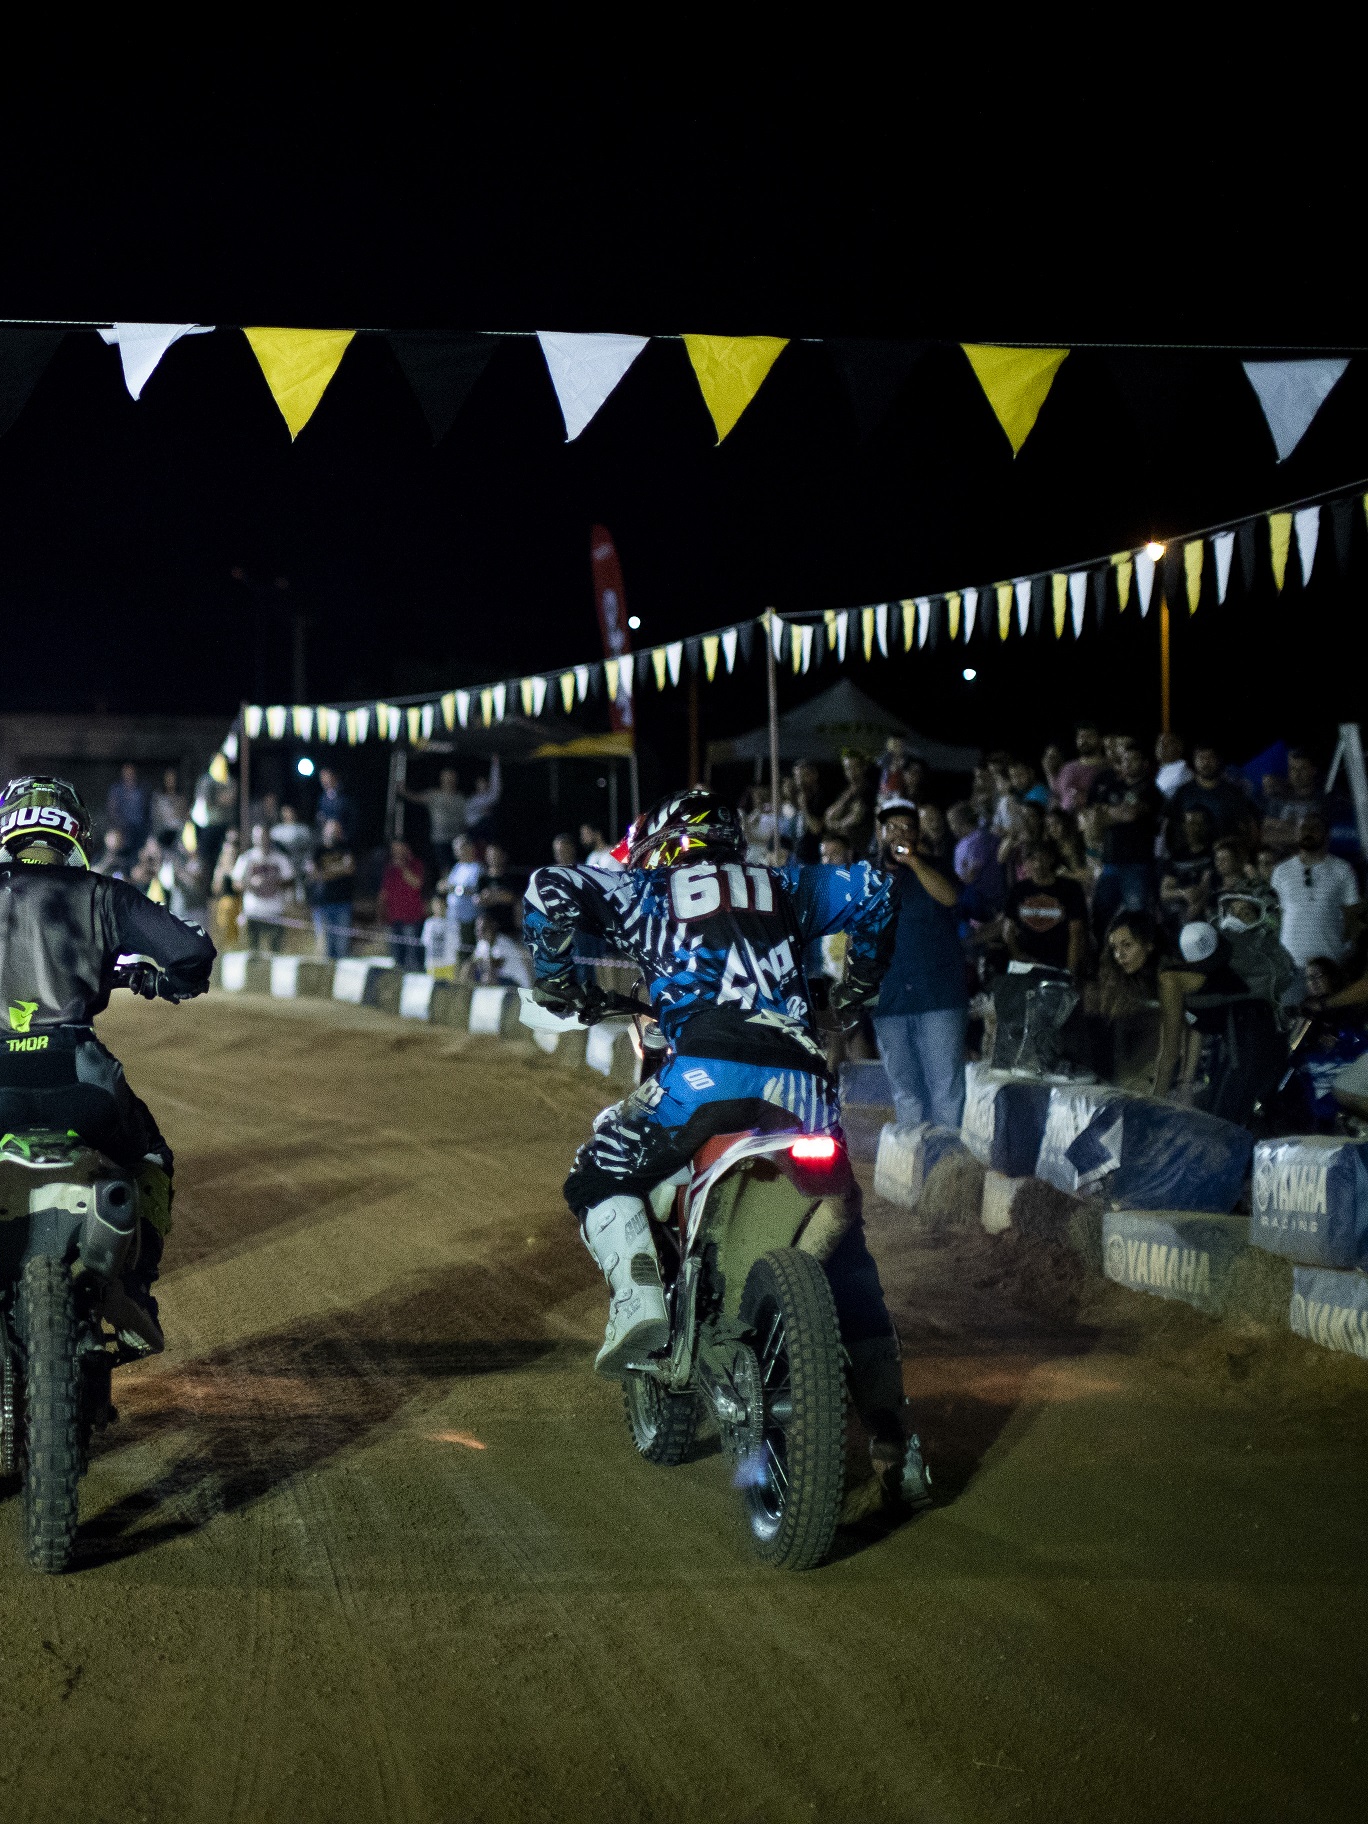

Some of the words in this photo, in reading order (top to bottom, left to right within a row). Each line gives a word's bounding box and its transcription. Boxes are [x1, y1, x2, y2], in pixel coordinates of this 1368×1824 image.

[670, 862, 775, 921] 611
[6, 1034, 50, 1053] THOR
[1266, 1162, 1328, 1215] YAMAHA
[1260, 1215, 1319, 1234] RACING
[1127, 1239, 1211, 1297] YAMAHA
